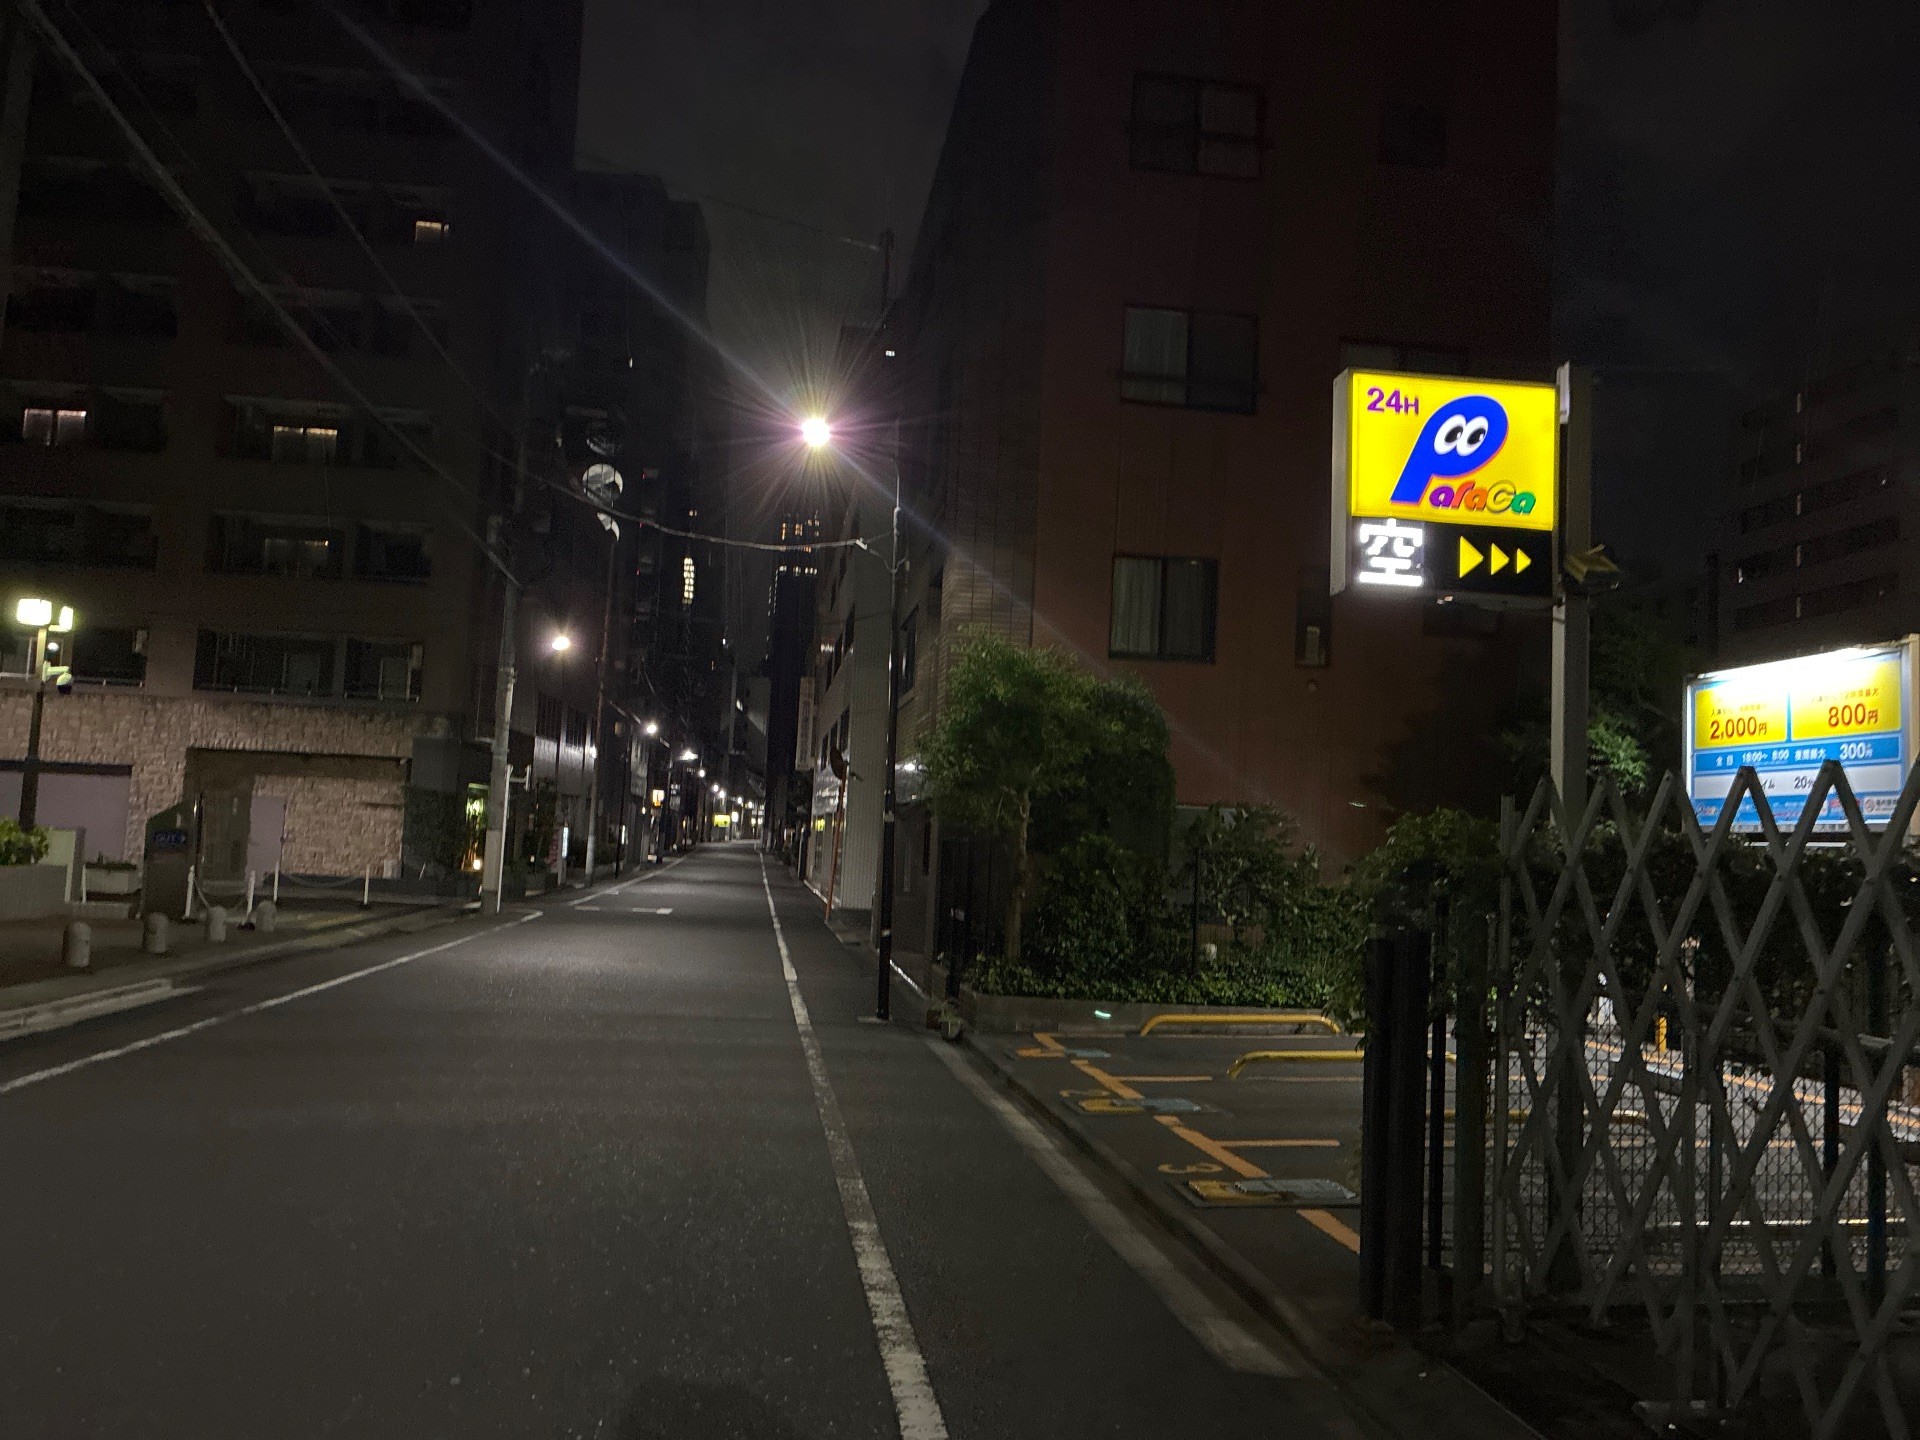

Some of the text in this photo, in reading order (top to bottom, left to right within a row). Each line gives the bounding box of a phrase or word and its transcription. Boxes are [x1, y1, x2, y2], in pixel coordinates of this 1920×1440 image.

[1367, 387, 1419, 416] 24H
[1358, 518, 1424, 587] 空
[1710, 716, 1768, 740] 2,000円
[1828, 703, 1879, 727] 800円
